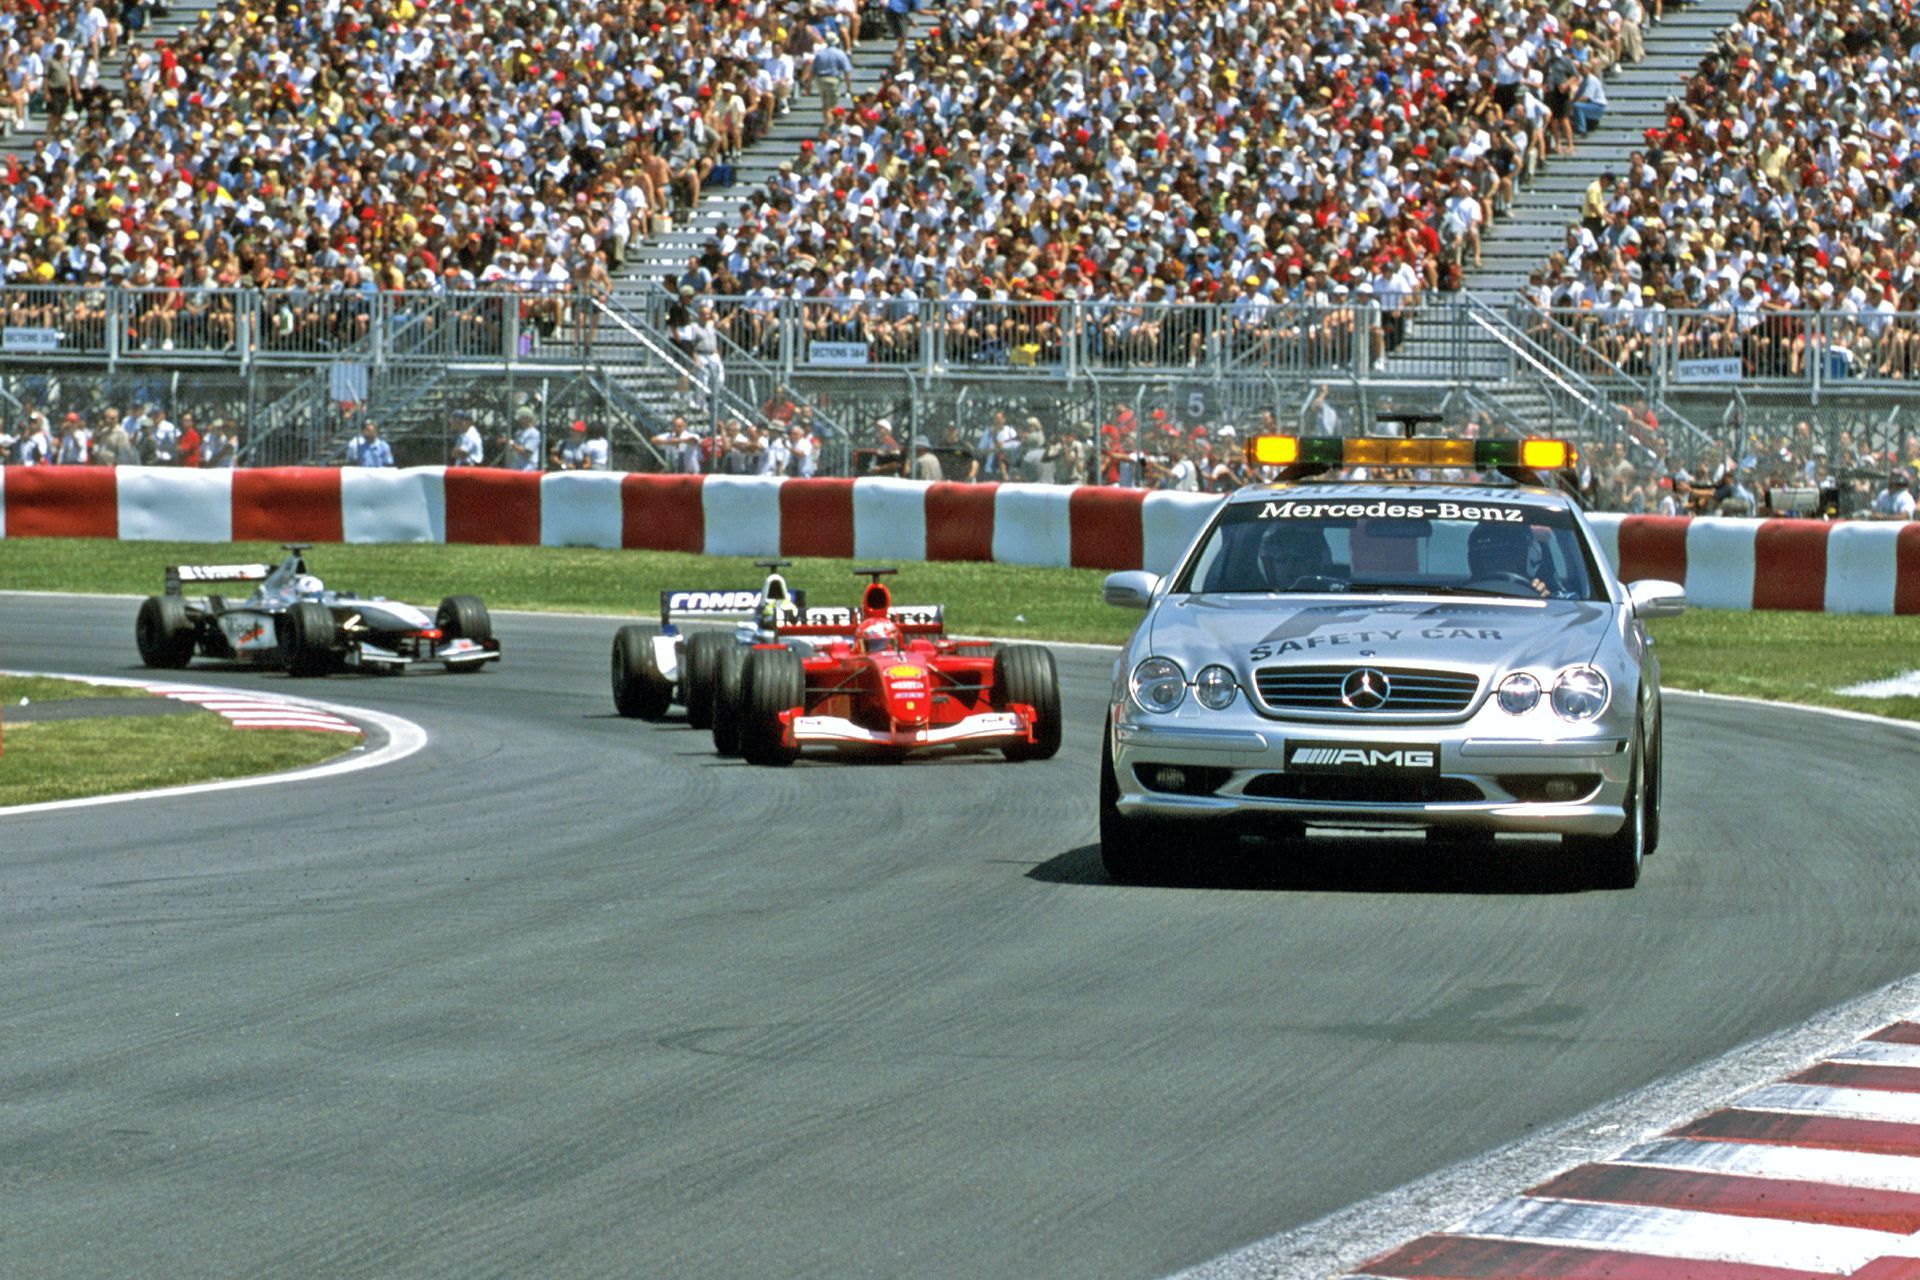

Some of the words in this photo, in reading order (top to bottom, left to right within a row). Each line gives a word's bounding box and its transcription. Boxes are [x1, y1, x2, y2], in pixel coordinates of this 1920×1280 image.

[812, 347, 847, 358] SECTIONS
[1681, 364, 1720, 377] SECTIONS
[1187, 392, 1205, 418] 5
[1258, 501, 1524, 522] Mercedes-Benz
[1250, 629, 1402, 661] SAFETY
[1420, 628, 1503, 641] CAR
